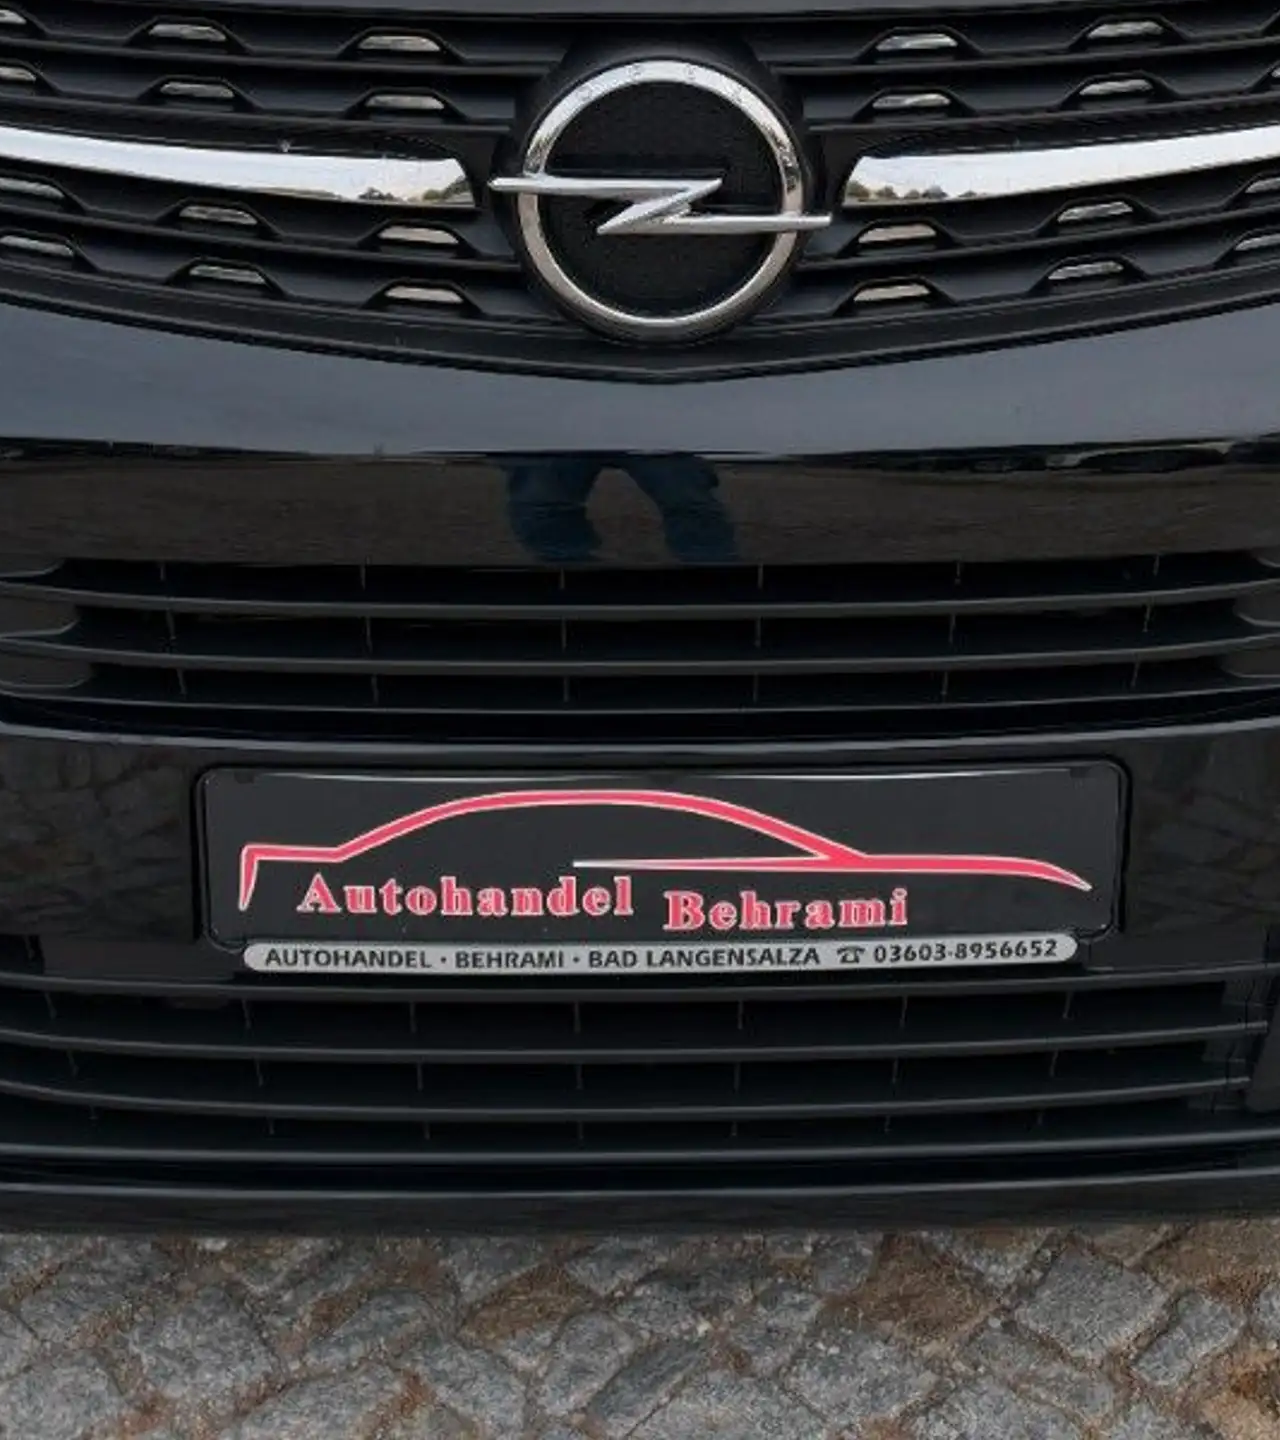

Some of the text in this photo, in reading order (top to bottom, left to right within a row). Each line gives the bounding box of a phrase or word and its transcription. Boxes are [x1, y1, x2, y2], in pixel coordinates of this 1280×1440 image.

[296, 872, 635, 916] Autohandel
[663, 887, 908, 930] Behrami
[265, 948, 432, 969] AUTOHANDEL
[455, 950, 564, 969] BEHRAMI
[588, 949, 638, 968] BAD
[647, 947, 820, 967] LANGENSALZA
